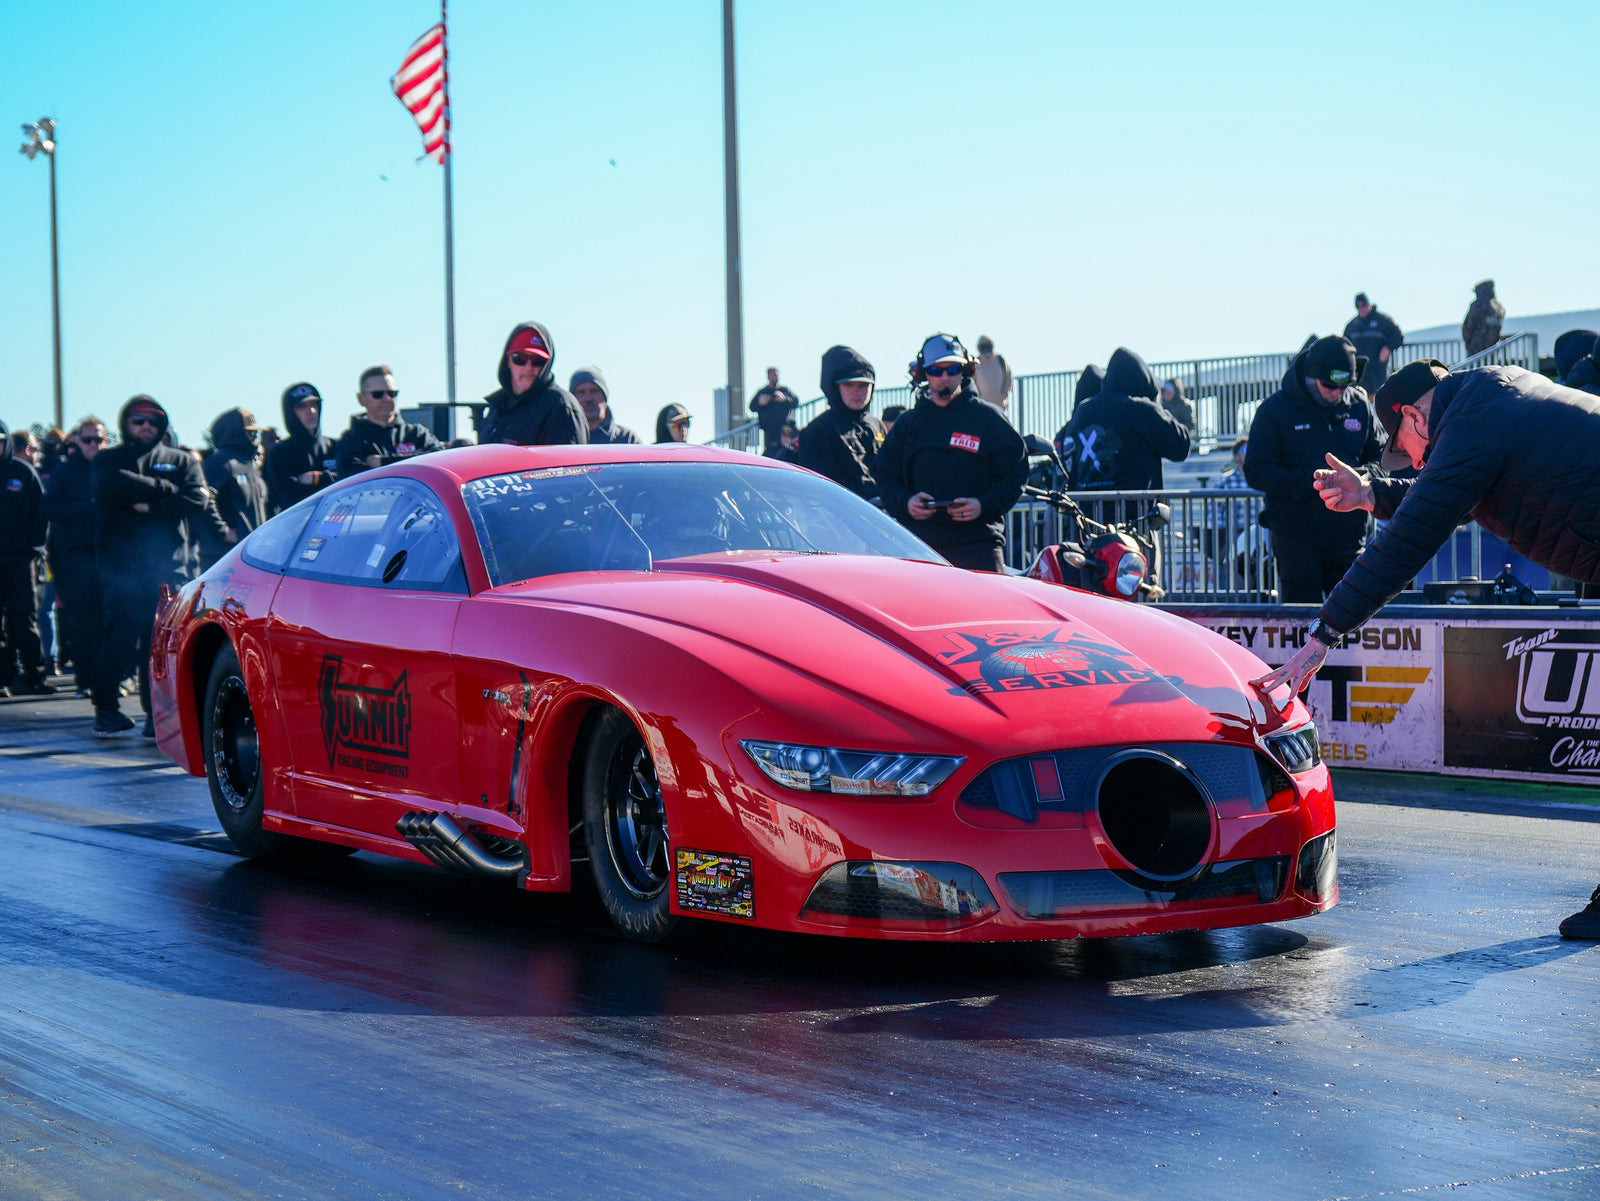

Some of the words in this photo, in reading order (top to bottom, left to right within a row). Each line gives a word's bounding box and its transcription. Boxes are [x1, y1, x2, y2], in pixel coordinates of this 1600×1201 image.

[476, 483, 533, 499] RVW
[1263, 626, 1422, 651] THPSON
[1503, 628, 1559, 660] Team
[958, 668, 1176, 696] SERVIC
[1320, 742, 1368, 761] EELS
[337, 752, 364, 770] RACING
[366, 758, 410, 779] EQUIPMENT
[691, 872, 715, 885] LIGHTS
[718, 872, 732, 888] OUT
